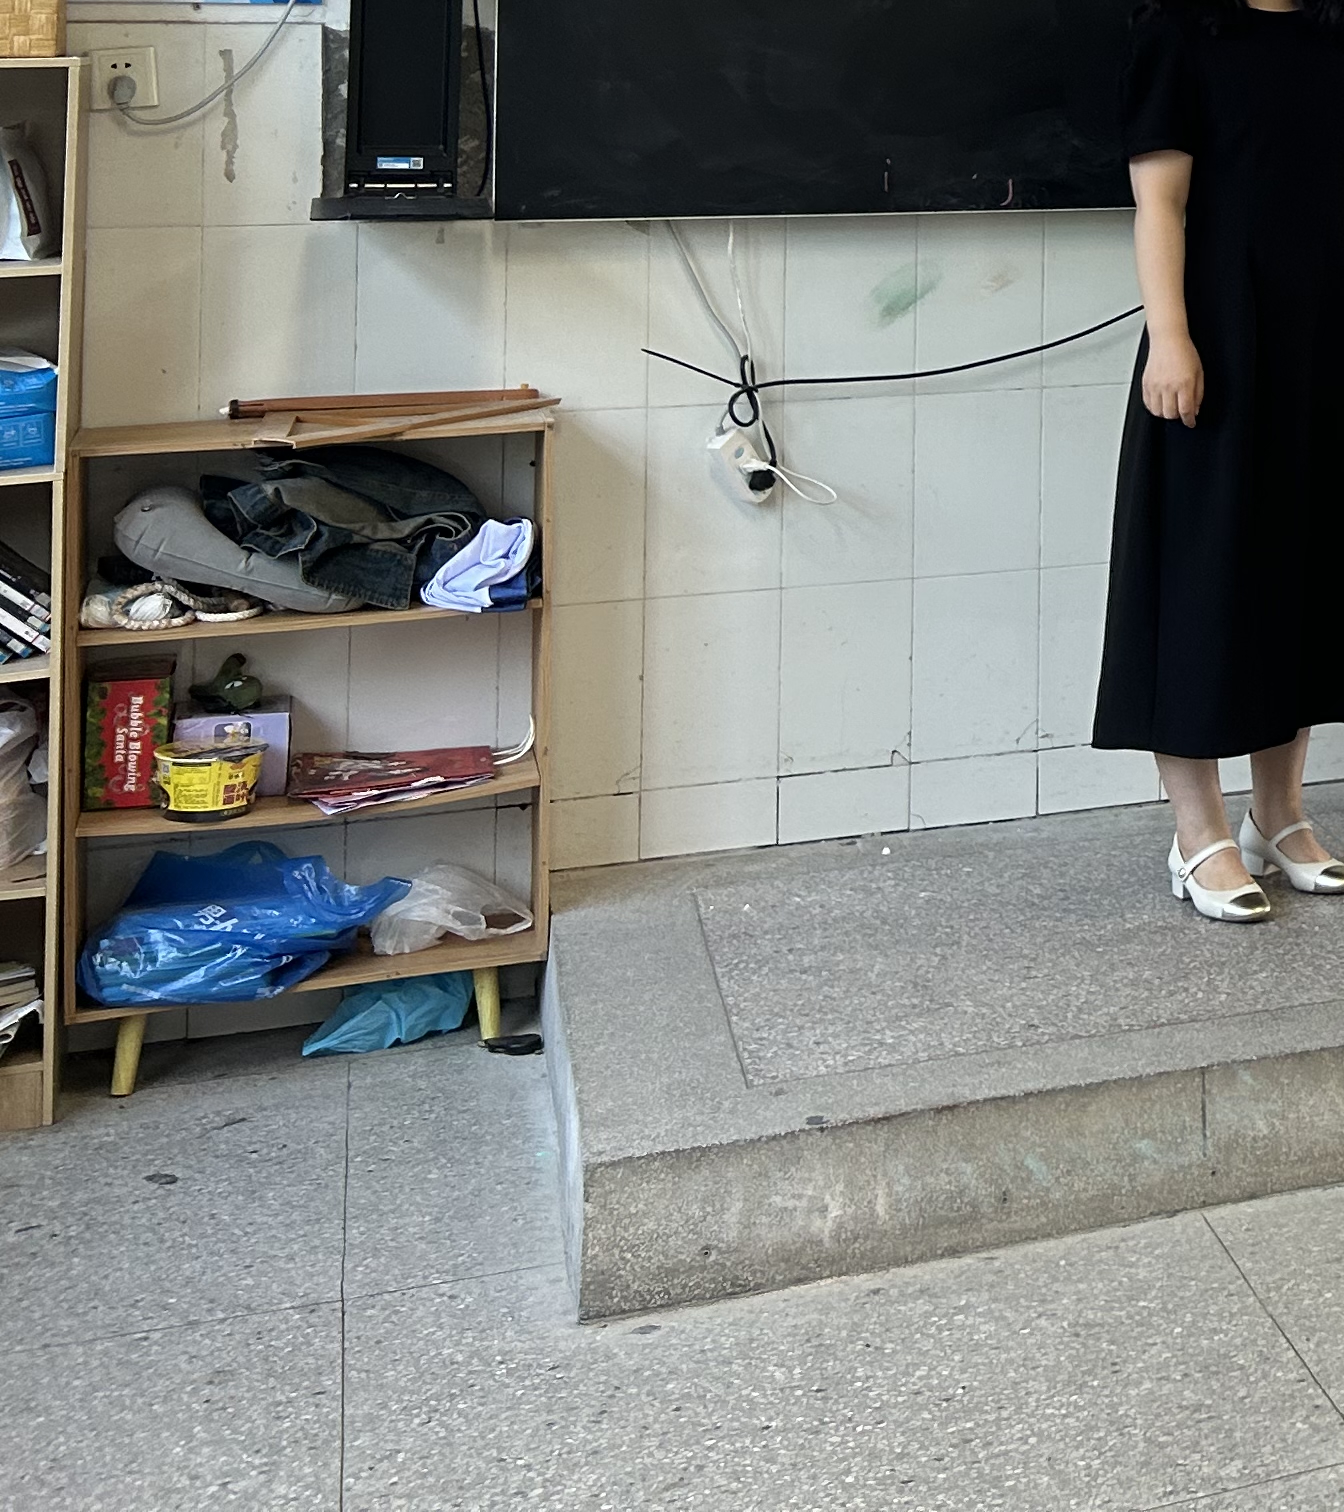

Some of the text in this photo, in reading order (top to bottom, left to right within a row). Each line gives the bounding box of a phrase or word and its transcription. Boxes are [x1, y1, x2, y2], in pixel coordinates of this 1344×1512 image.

[113, 726, 129, 764] Santa
[123, 695, 144, 793] Bubble Blowing
